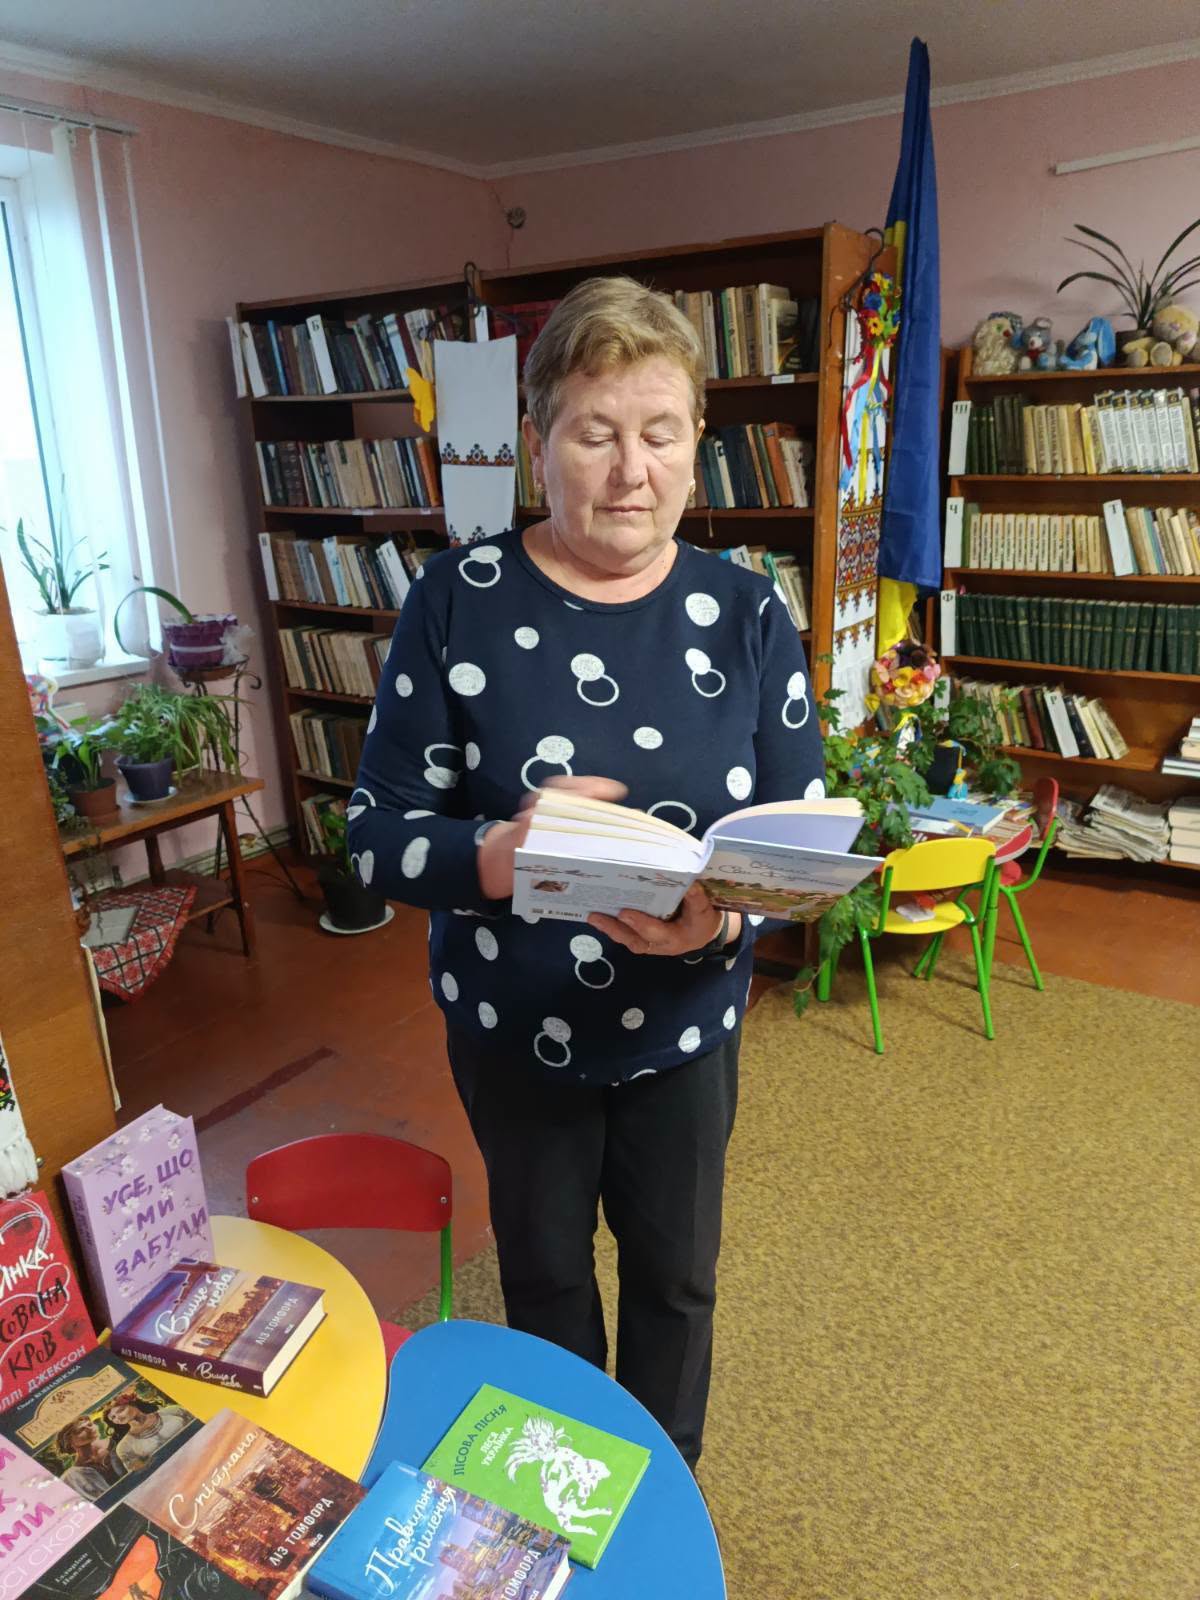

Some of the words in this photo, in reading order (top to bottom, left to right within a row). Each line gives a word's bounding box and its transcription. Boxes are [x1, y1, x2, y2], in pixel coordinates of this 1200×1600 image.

[103, 1174, 154, 1215] УСЕ,
[156, 1148, 194, 1183] ЩО
[136, 1197, 175, 1231] МИ
[114, 1206, 208, 1276] ЗАБУЛИ
[155, 1285, 209, 1340] Вище
[206, 1270, 235, 1308] неба
[255, 1329, 271, 1345] ЛІЗ
[268, 1296, 299, 1333] ТОМФОРД
[27, 1345, 87, 1393] ДЖЕКСОН
[453, 1433, 478, 1476] ЛІСОВА
[474, 1404, 508, 1432] ПІСНЯ
[168, 1429, 260, 1530] Спіймана
[28, 1511, 86, 1567] СКОР
[268, 1546, 289, 1567] ЛІЗ
[284, 1497, 335, 1546] ТОМФОРД
[364, 1478, 437, 1597] Правильне
[409, 1486, 457, 1568] рішення
